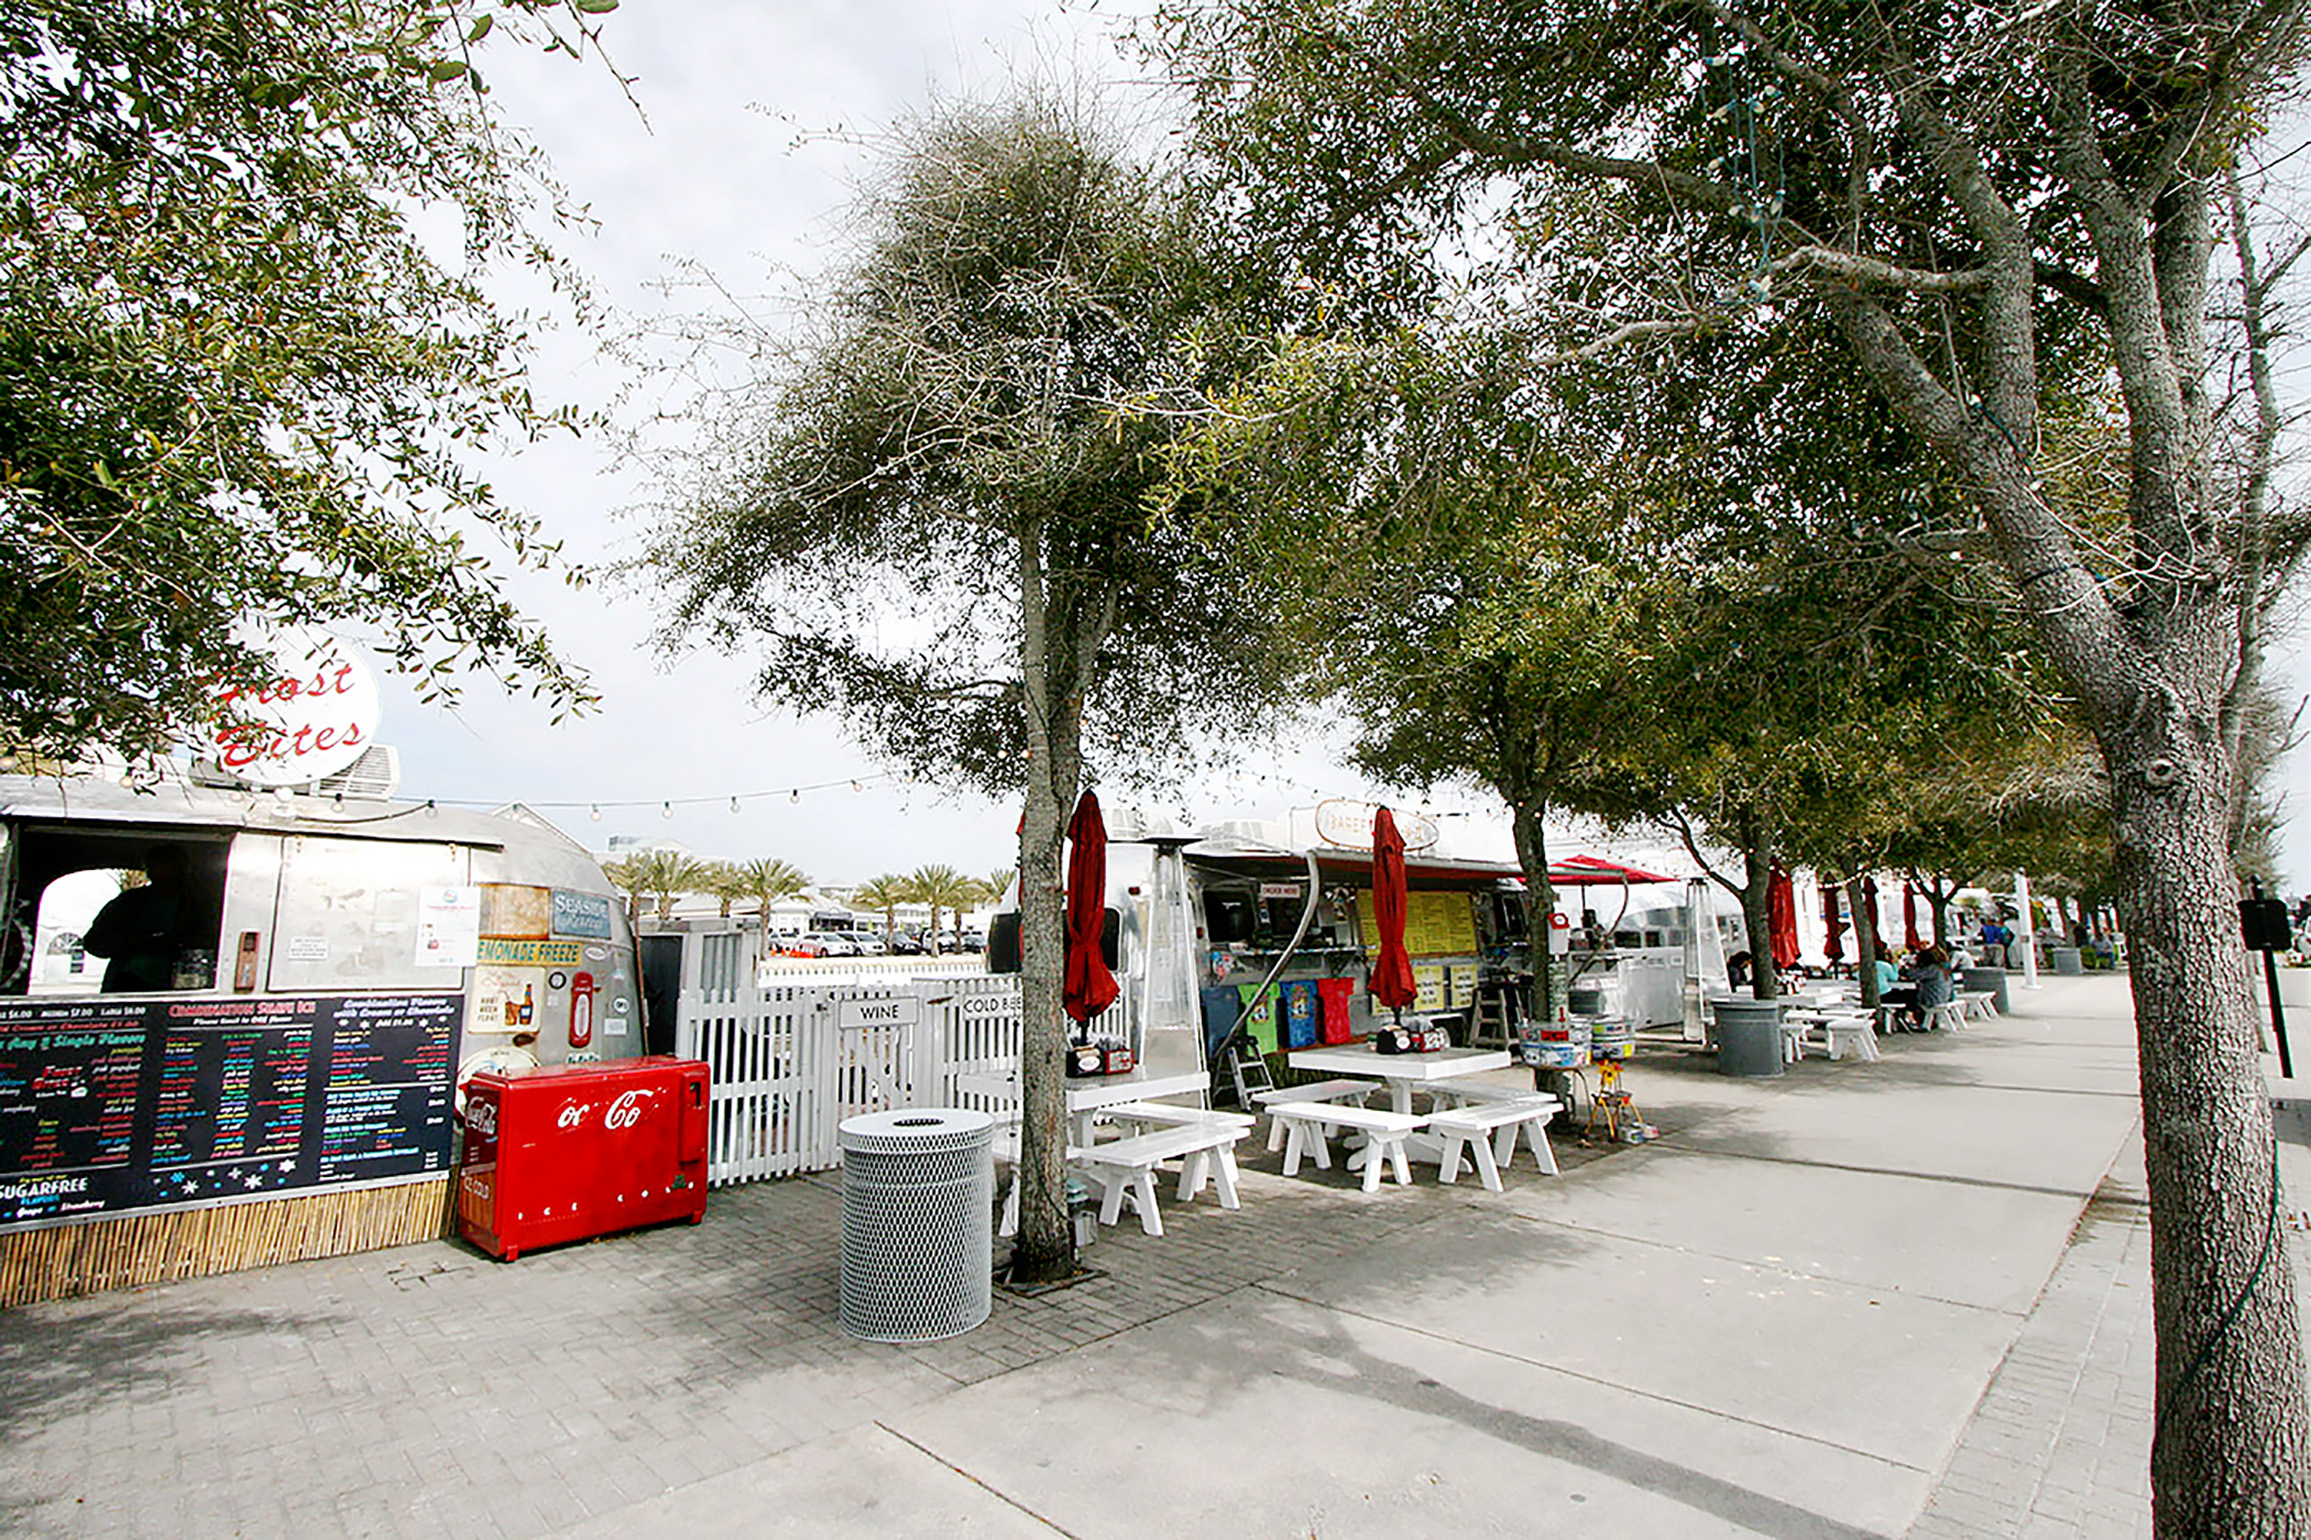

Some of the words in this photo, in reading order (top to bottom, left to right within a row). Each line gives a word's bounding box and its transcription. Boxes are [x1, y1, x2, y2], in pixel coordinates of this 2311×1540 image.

[477, 941, 536, 961] EMONADE
[860, 1004, 899, 1019] WINE
[963, 997, 999, 1013] COLD
[1001, 996, 1022, 1011] BEE
[0, 1177, 88, 1200] SUGARFREE
